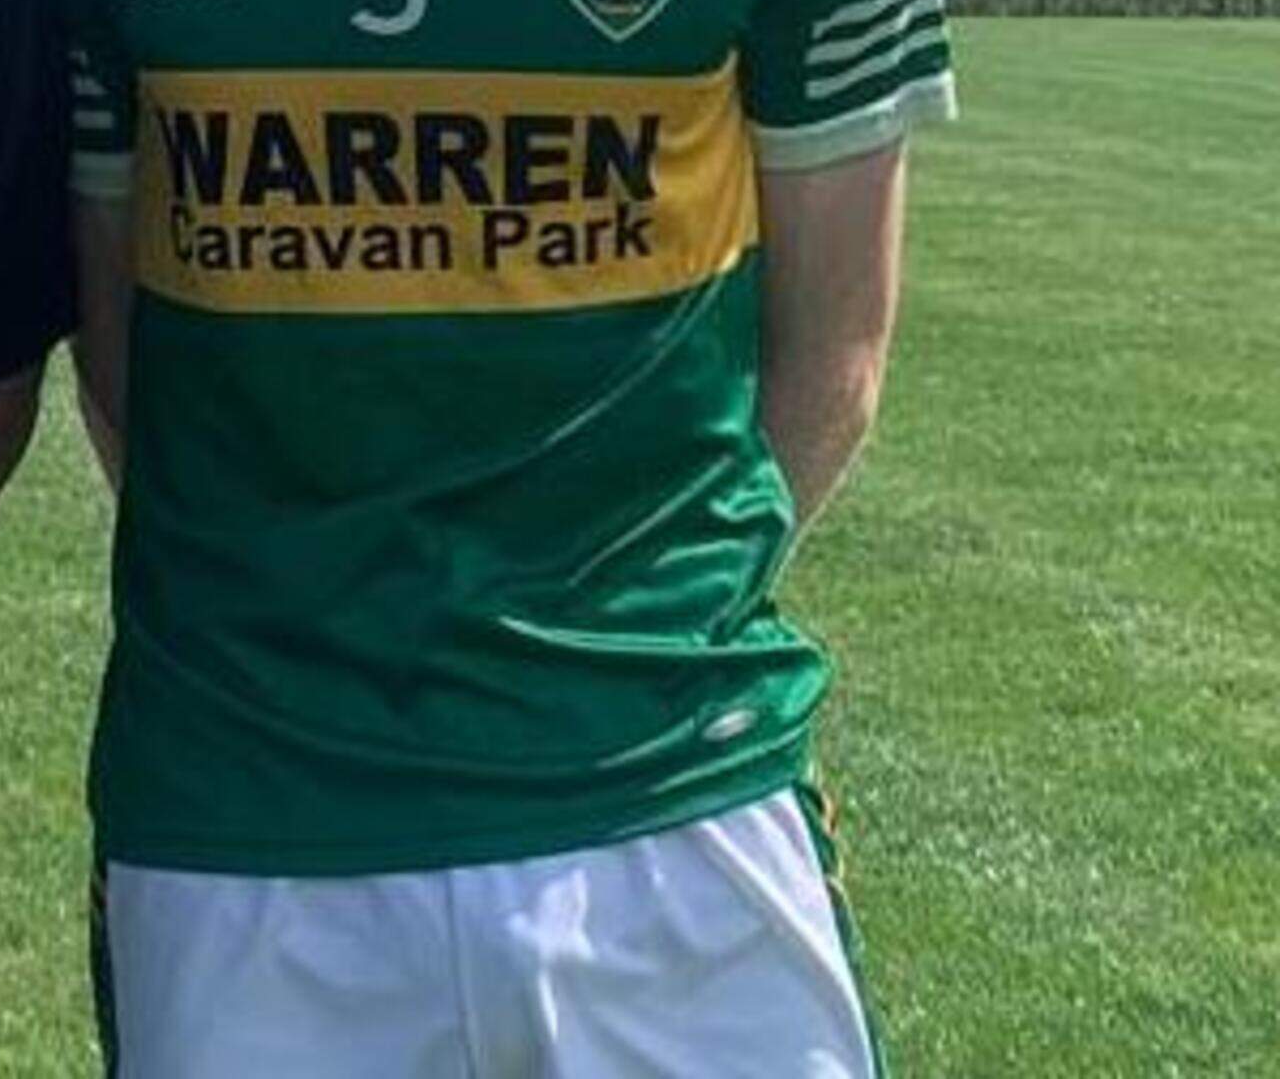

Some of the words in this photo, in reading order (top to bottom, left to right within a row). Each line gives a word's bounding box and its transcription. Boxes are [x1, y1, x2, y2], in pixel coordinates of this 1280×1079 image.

[154, 109, 662, 207] WARREN
[169, 204, 452, 272] Caravan
[482, 205, 654, 271] Park
